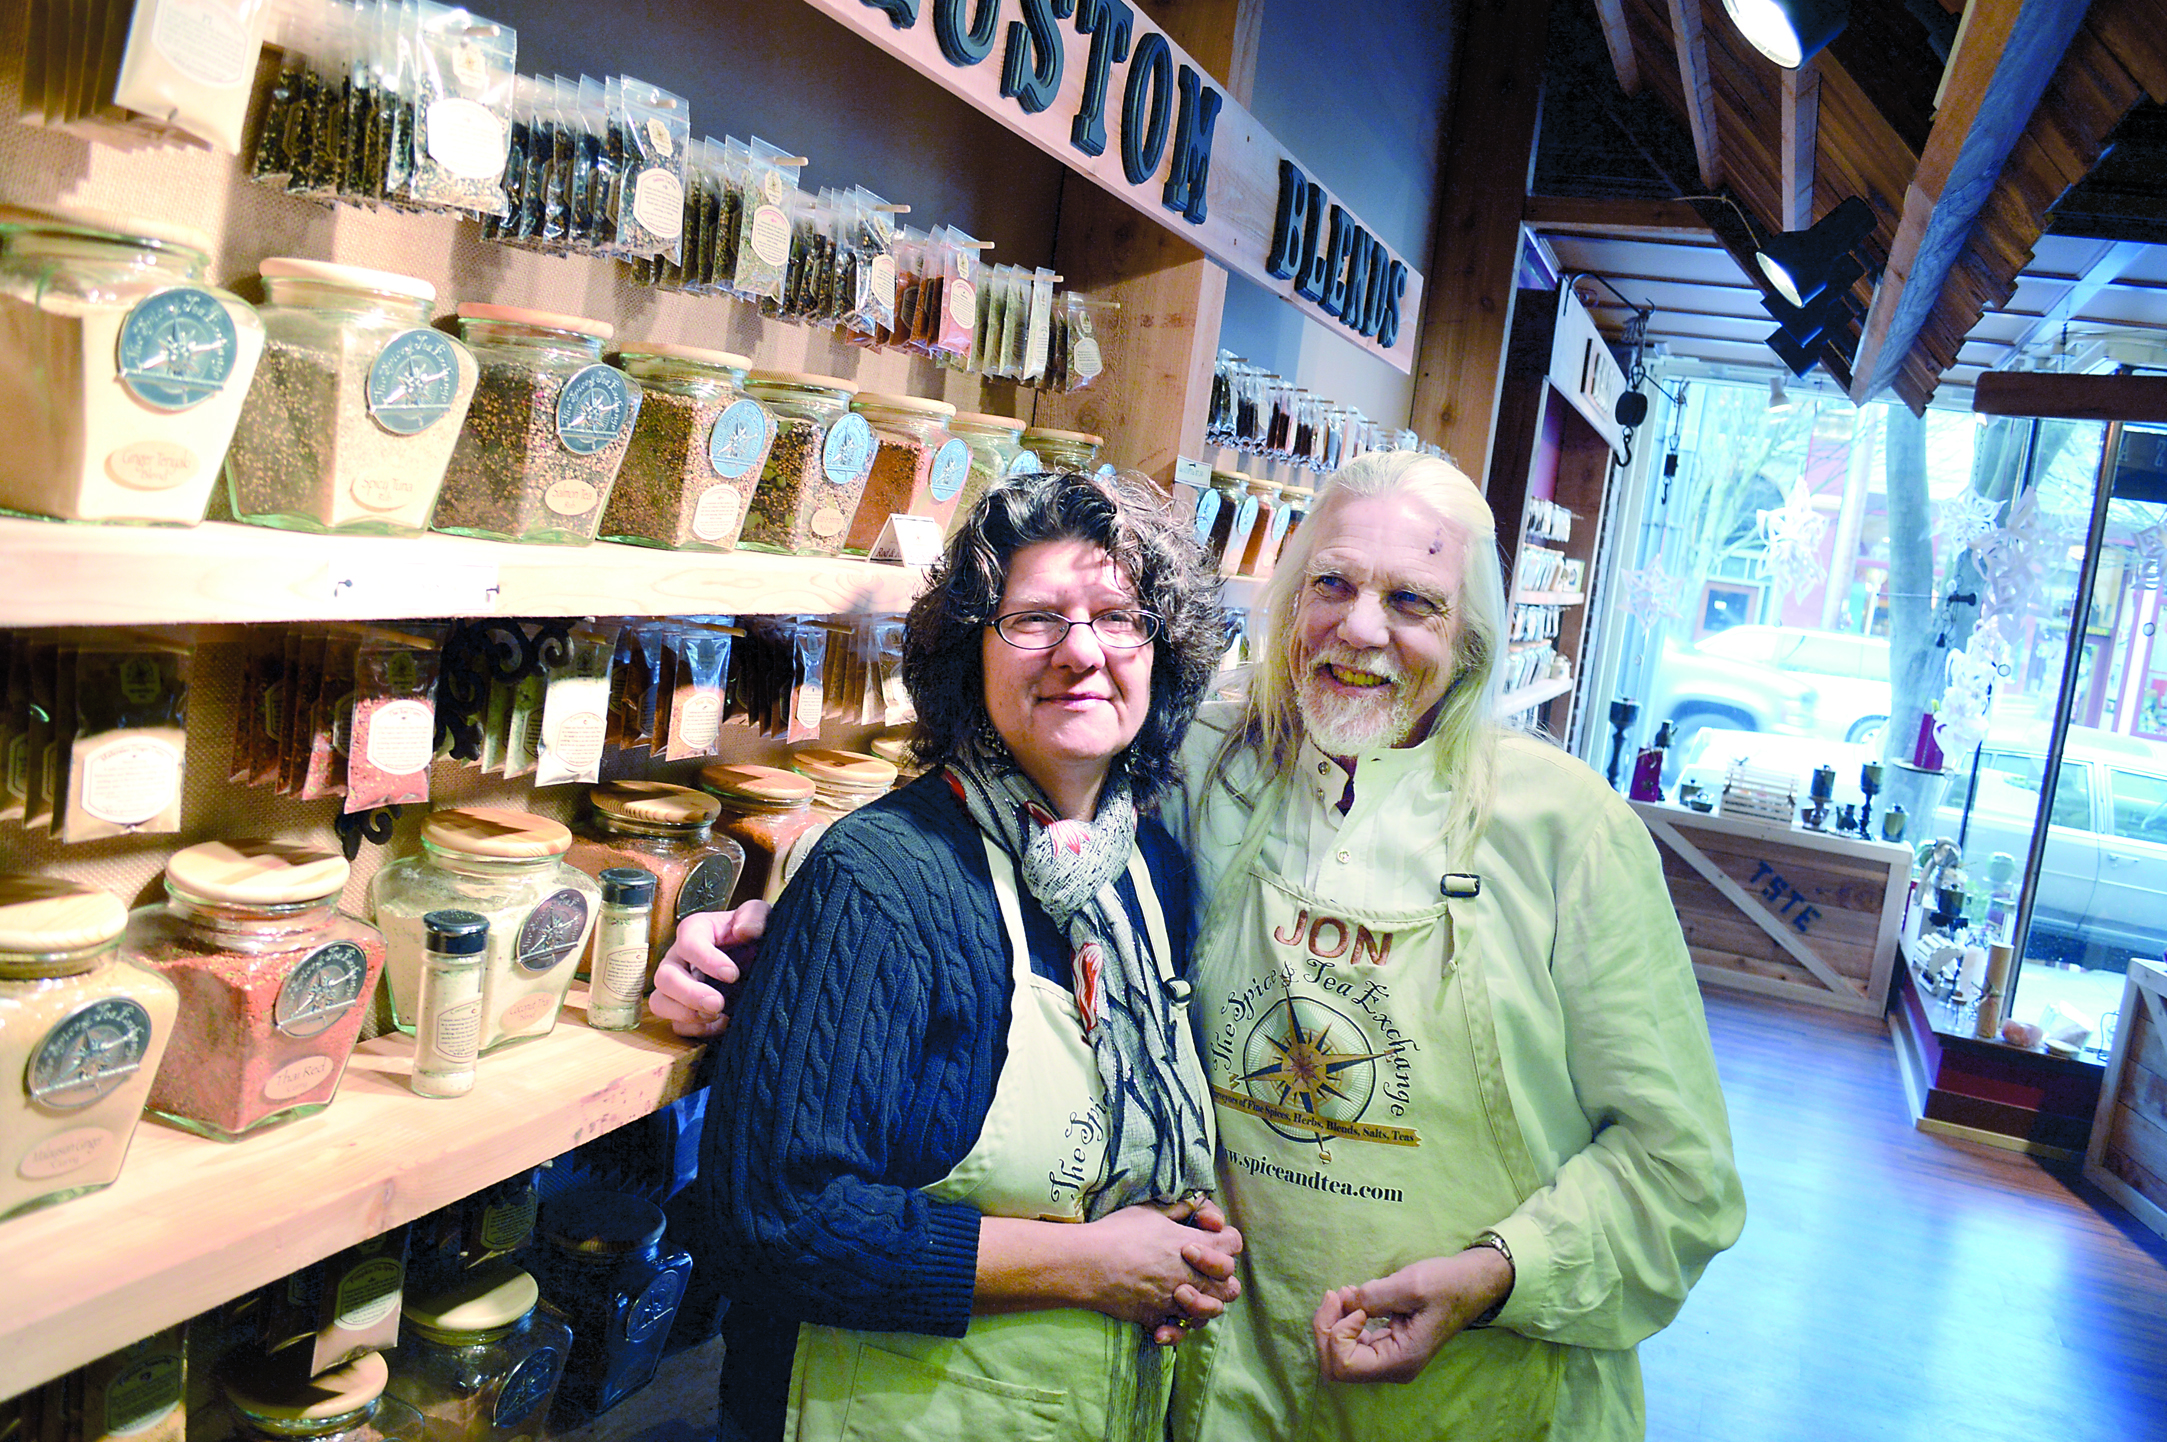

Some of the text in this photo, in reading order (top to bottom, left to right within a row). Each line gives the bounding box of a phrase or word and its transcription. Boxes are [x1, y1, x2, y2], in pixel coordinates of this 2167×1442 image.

[1266, 158, 1409, 349] BLENDS
[361, 477, 413, 497] Spicy Tuna
[1749, 860, 1823, 933] TSTE
[1273, 909, 1394, 966] JON
[1221, 968, 1277, 1022] Spice
[1302, 958, 1354, 998] Tea
[276, 1056, 327, 1087] Thai Red
[1209, 1023, 1237, 1072] The
[1350, 979, 1421, 1118] Exchange
[1247, 1098, 1265, 1113] Fine
[1265, 1105, 1292, 1122] Spices,
[1293, 1112, 1324, 1130] Herbs,
[1326, 1119, 1361, 1137] Blends,
[1362, 1126, 1390, 1141] Salts,
[1391, 1129, 1415, 1143] Teas
[1049, 1148, 1086, 1202] The
